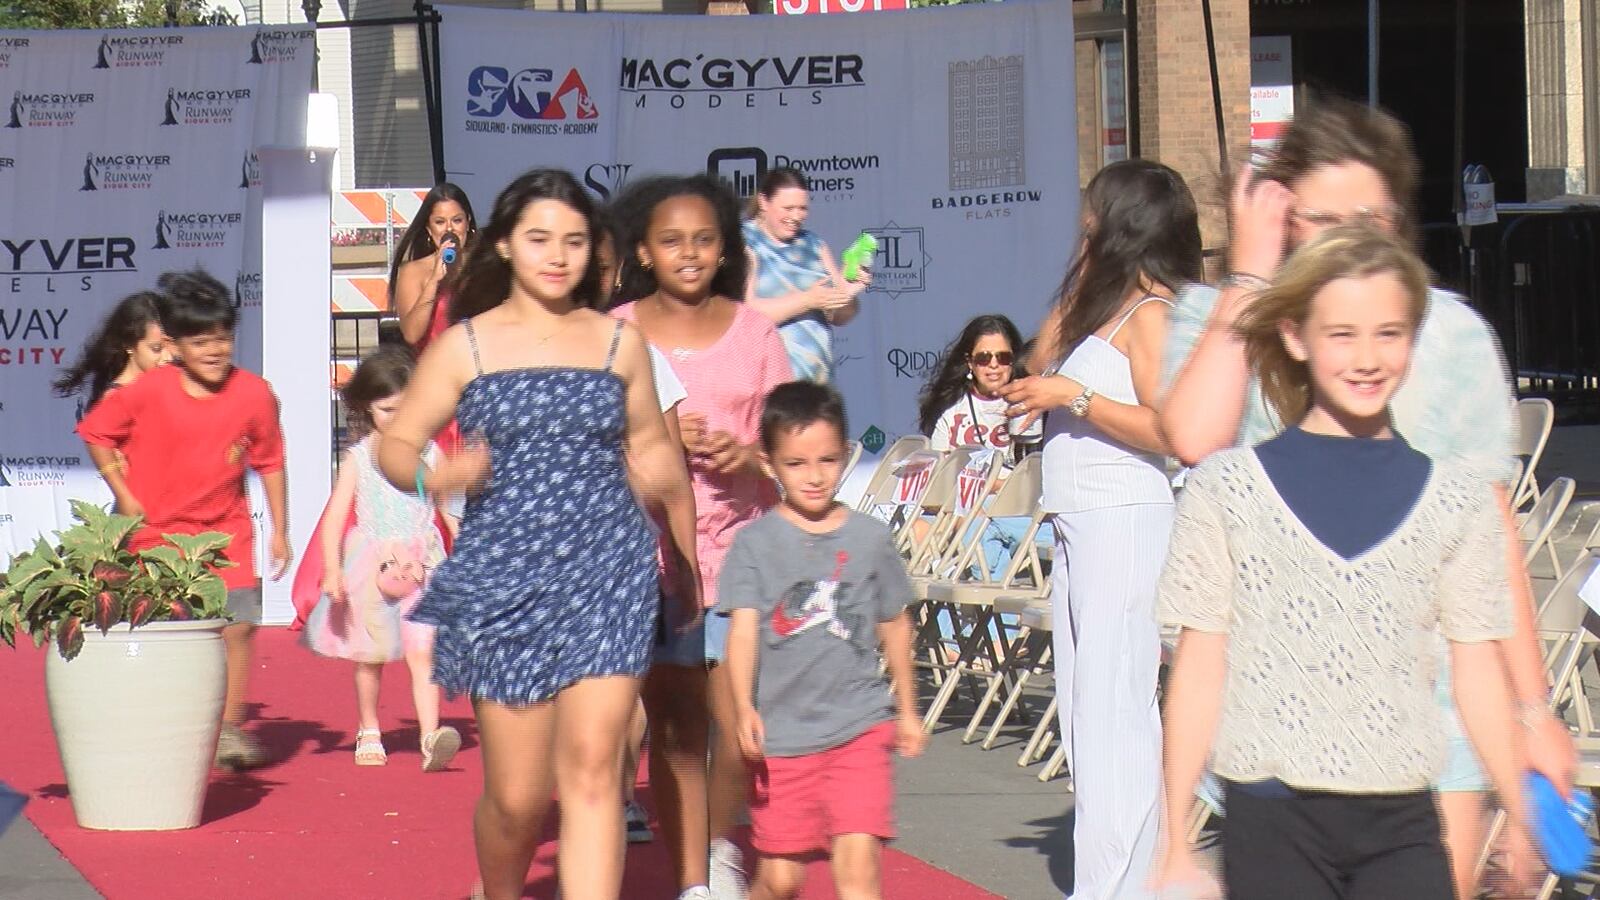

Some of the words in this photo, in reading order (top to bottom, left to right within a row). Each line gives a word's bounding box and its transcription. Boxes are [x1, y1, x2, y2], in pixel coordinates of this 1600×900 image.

[117, 50, 165, 61] RUNWAY
[635, 91, 822, 108] MODELS
[29, 109, 76, 121] RUNWAY
[185, 106, 234, 118] RUNWAY
[465, 120, 506, 133] SIOUXLAND
[511, 123, 558, 135] GYMNASTICS
[563, 122, 599, 135] ACADEMY
[774, 154, 879, 172] Downtown
[104, 172, 153, 182] RUNWAY
[808, 176, 855, 192] tners
[931, 190, 1042, 209] BADGEROW
[965, 208, 1012, 221] FLATS
[177, 230, 226, 242] RUNWAY
[894, 272, 918, 280] LOOK
[11, 276, 92, 293] ELS
[0, 347, 65, 365] CITY
[17, 470, 65, 481] RUNWAY
[900, 468, 930, 501] VIP
